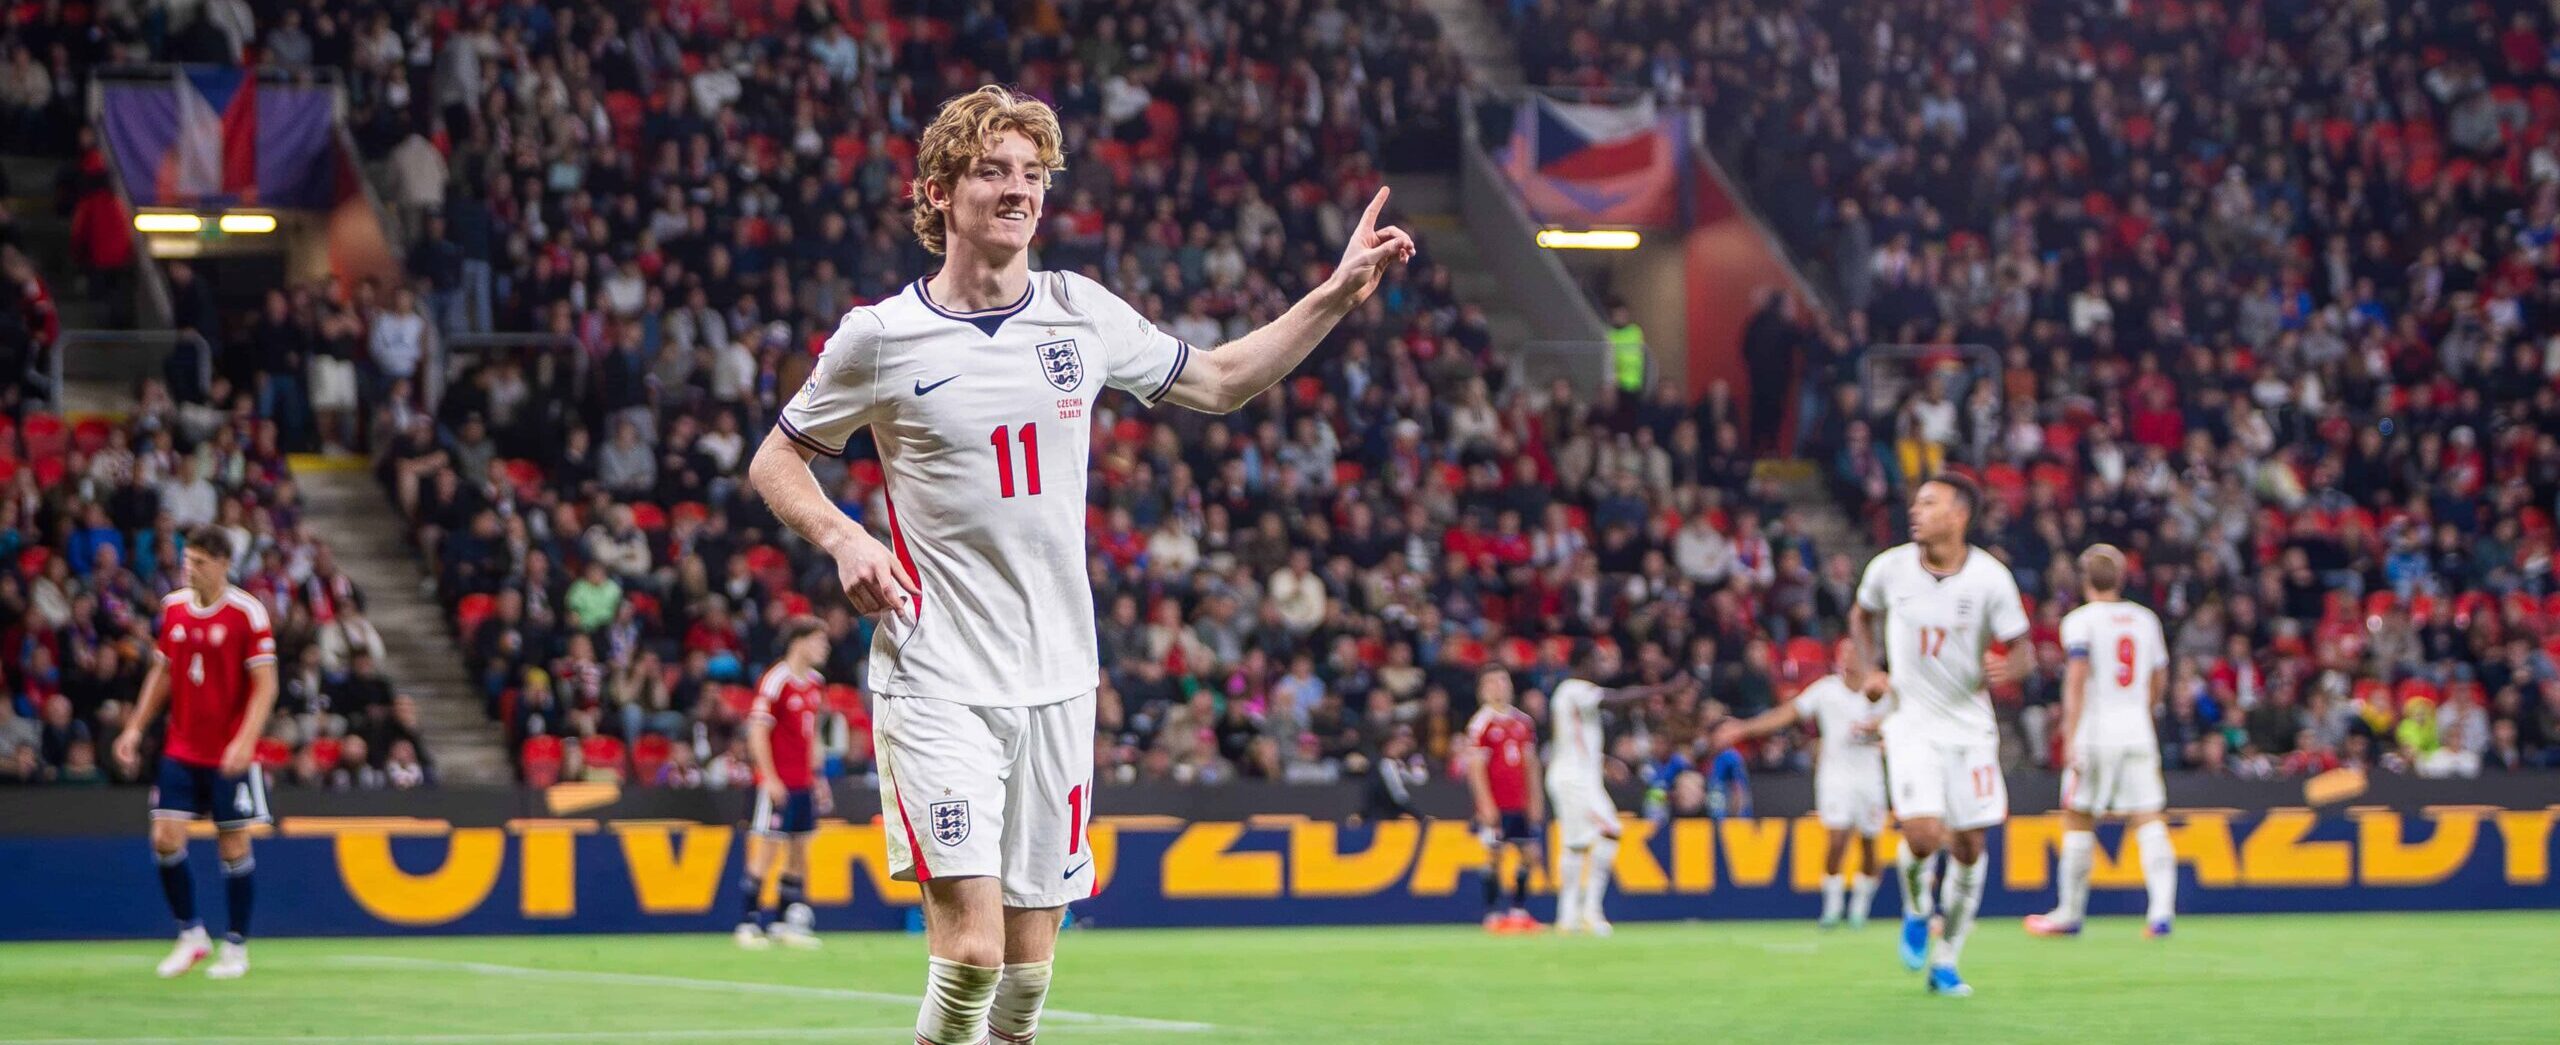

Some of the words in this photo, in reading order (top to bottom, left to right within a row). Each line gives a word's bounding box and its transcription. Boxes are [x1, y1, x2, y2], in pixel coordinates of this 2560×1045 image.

[1057, 398, 1082, 408] CZECHIA
[990, 422, 1042, 498] 11
[1920, 626, 1947, 658] 17
[2115, 636, 2136, 688] 9
[187, 651, 205, 687] 4
[1067, 778, 1090, 856] 1
